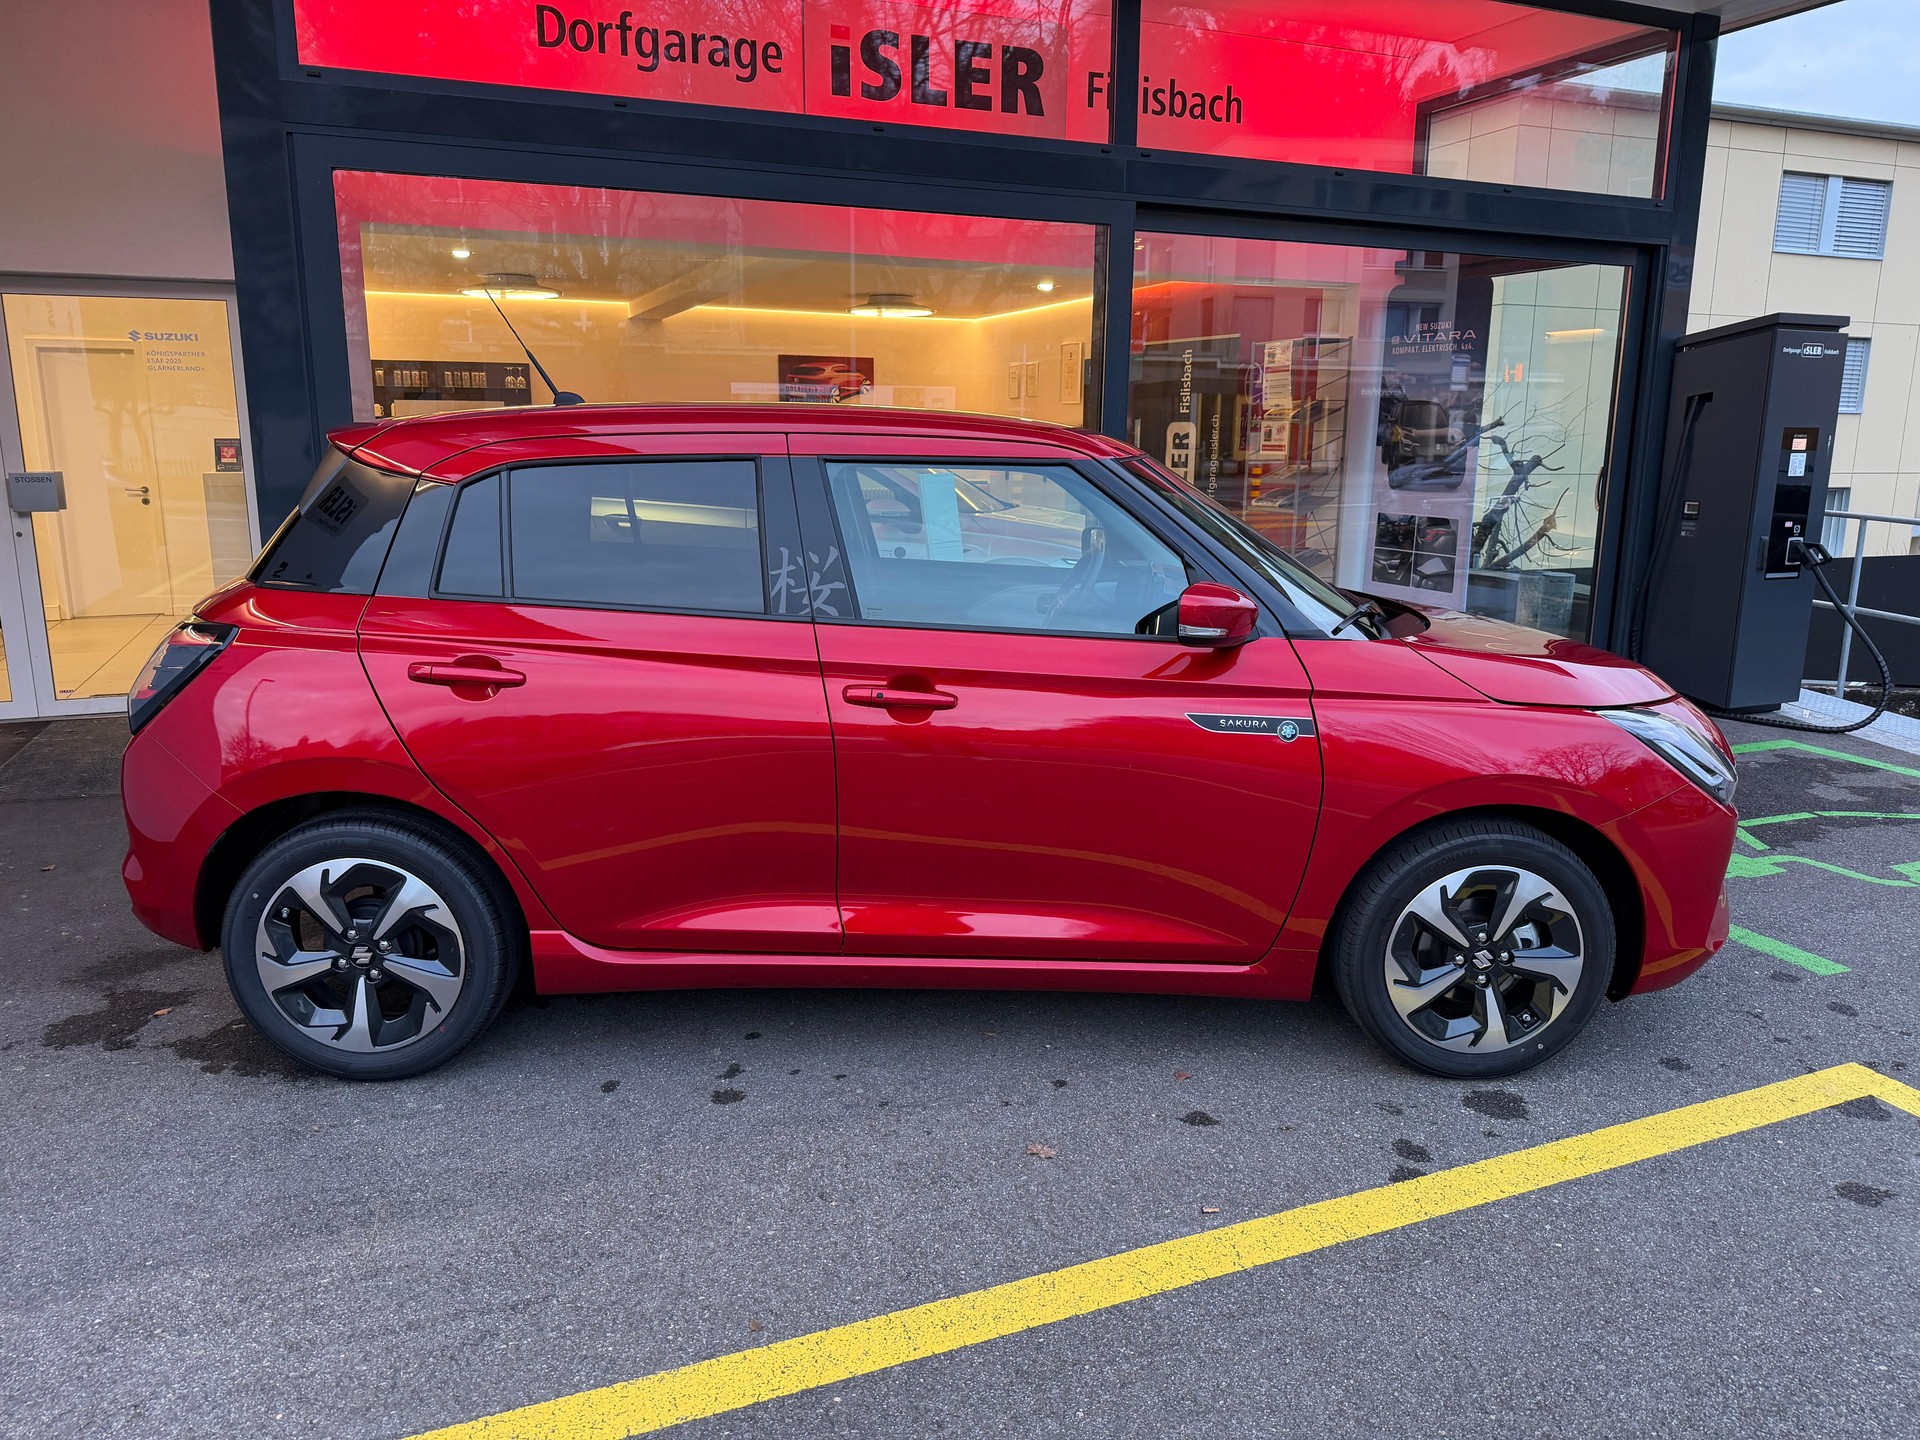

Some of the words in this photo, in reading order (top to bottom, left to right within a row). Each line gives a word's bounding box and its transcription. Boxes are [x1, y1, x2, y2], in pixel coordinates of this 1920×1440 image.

[536, 4, 783, 83] Dorfgarage
[830, 24, 1045, 117] iSLER
[1415, 323, 1428, 332] NEW
[1430, 320, 1452, 331] SUZUKI
[144, 332, 199, 342] SUZUKI
[1404, 329, 1477, 343] VITARA
[146, 350, 206, 358] KÖNIGSPARTNER
[1391, 345, 1420, 355] KOMPAKT.
[1421, 342, 1459, 353] ELEKTRISCH.
[165, 357, 182, 365] 2025
[1179, 349, 1193, 414] Fislisbach
[769, 545, 846, 617] 桜
[1219, 719, 1268, 728] SAKURA
